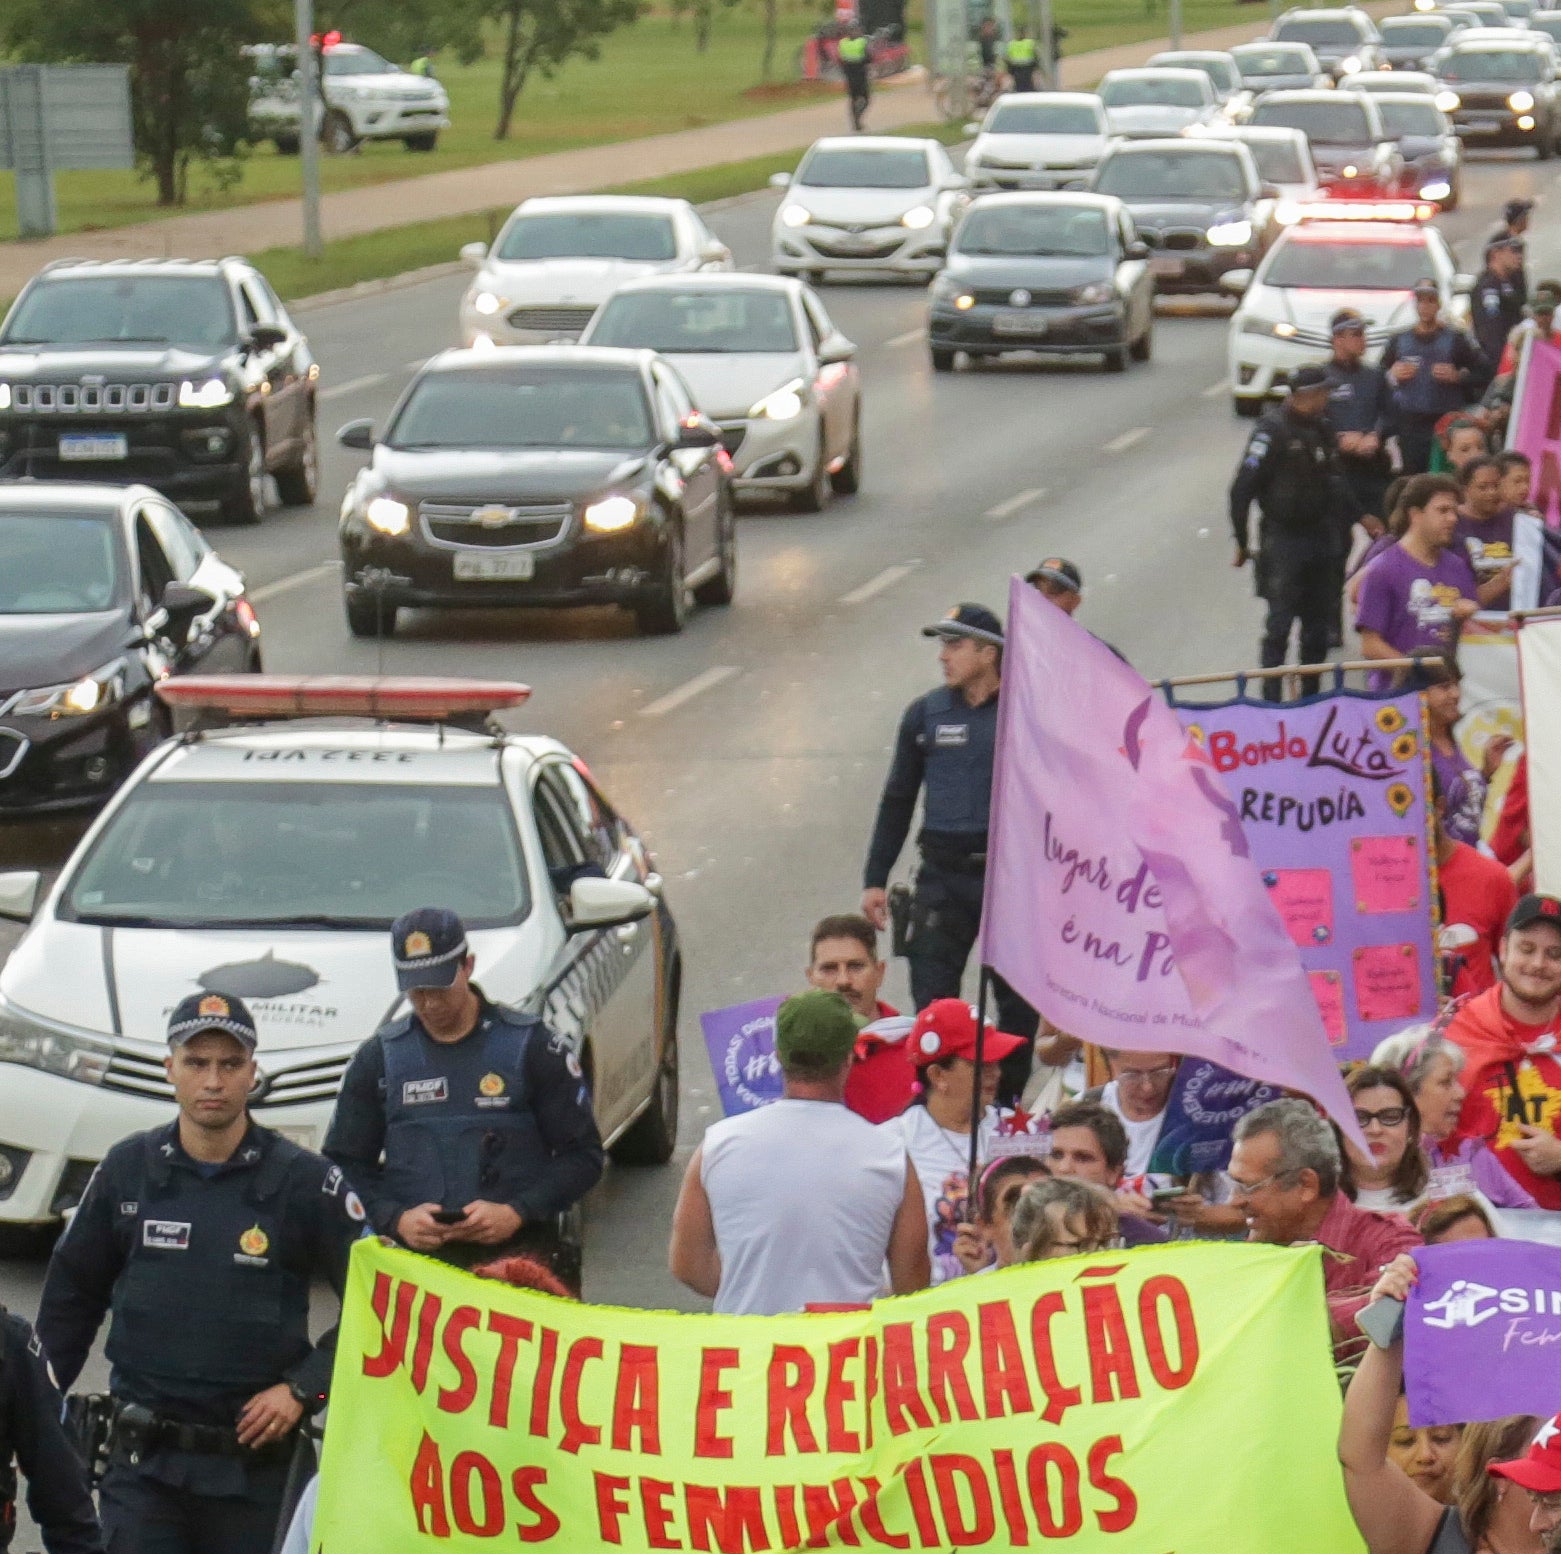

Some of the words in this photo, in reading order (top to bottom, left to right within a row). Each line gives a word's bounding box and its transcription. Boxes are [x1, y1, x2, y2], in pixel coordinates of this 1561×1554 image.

[1092, 997, 1149, 1026] Nacional
[1152, 1012, 1168, 1025] de
[1171, 1012, 1202, 1030] Mulh
[362, 1270, 662, 1456] JUSTIÇA
[694, 1347, 740, 1459] E
[410, 1429, 562, 1545] AOS
